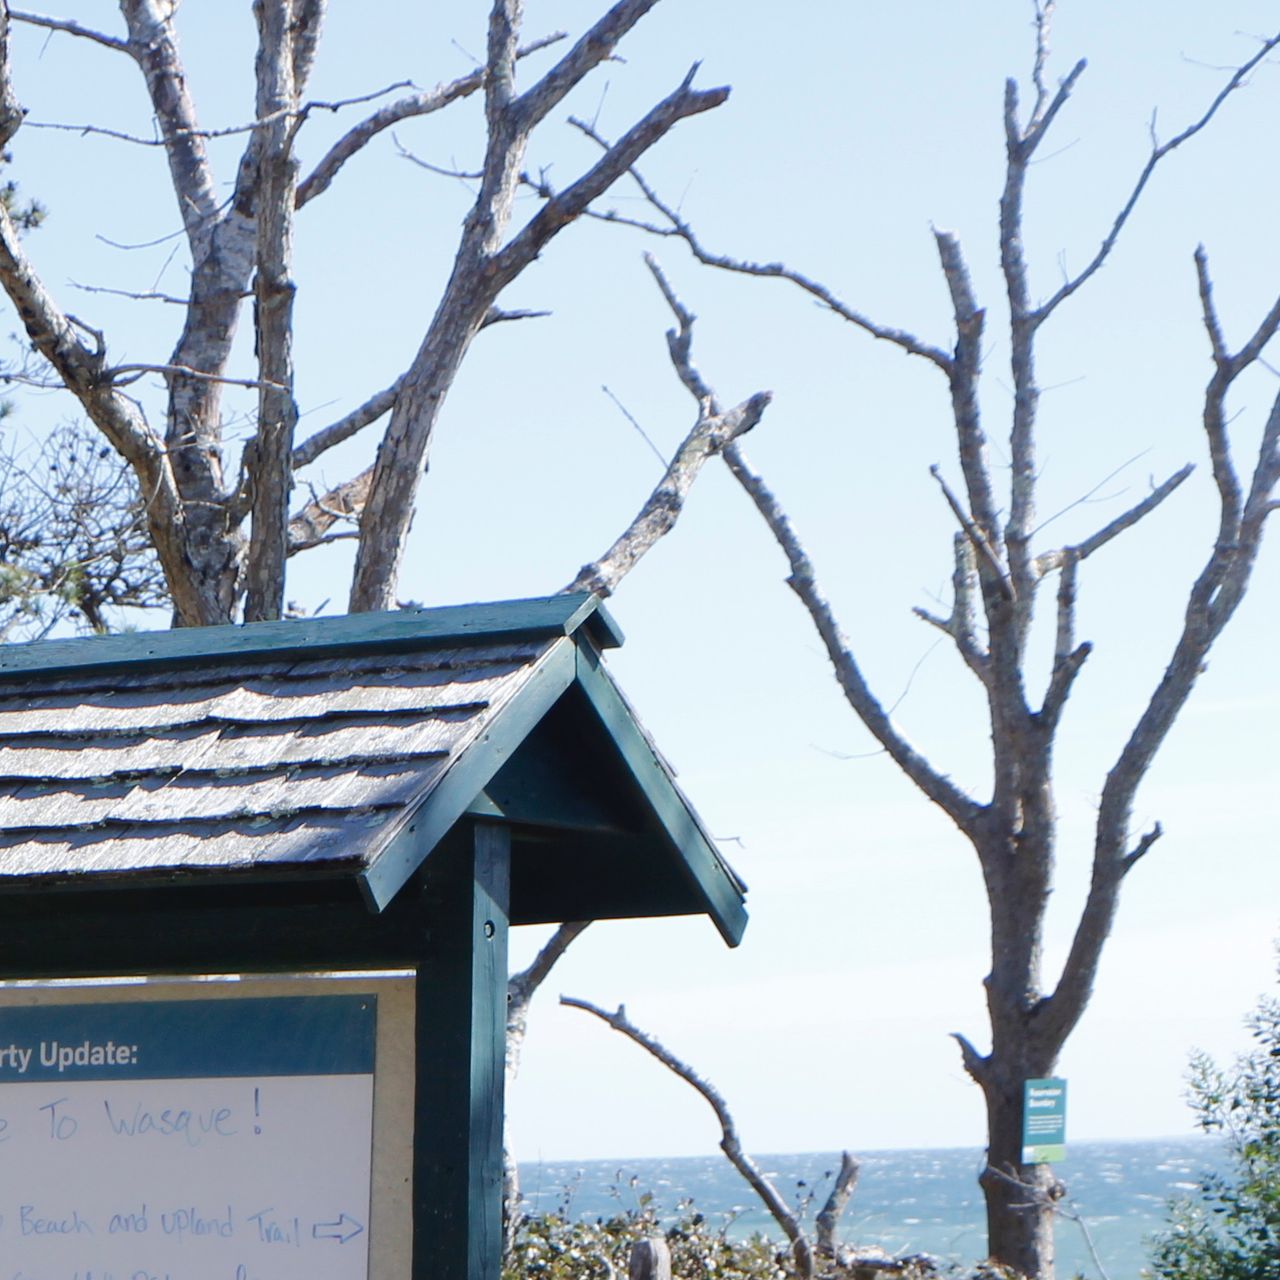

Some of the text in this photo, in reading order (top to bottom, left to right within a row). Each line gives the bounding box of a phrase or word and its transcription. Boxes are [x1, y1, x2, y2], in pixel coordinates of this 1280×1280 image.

[40, 1041, 139, 1072] Update:
[40, 1098, 78, 1140] To
[19, 1205, 95, 1236] Beach
[109, 1203, 149, 1233] and
[247, 1208, 301, 1248] Trail
